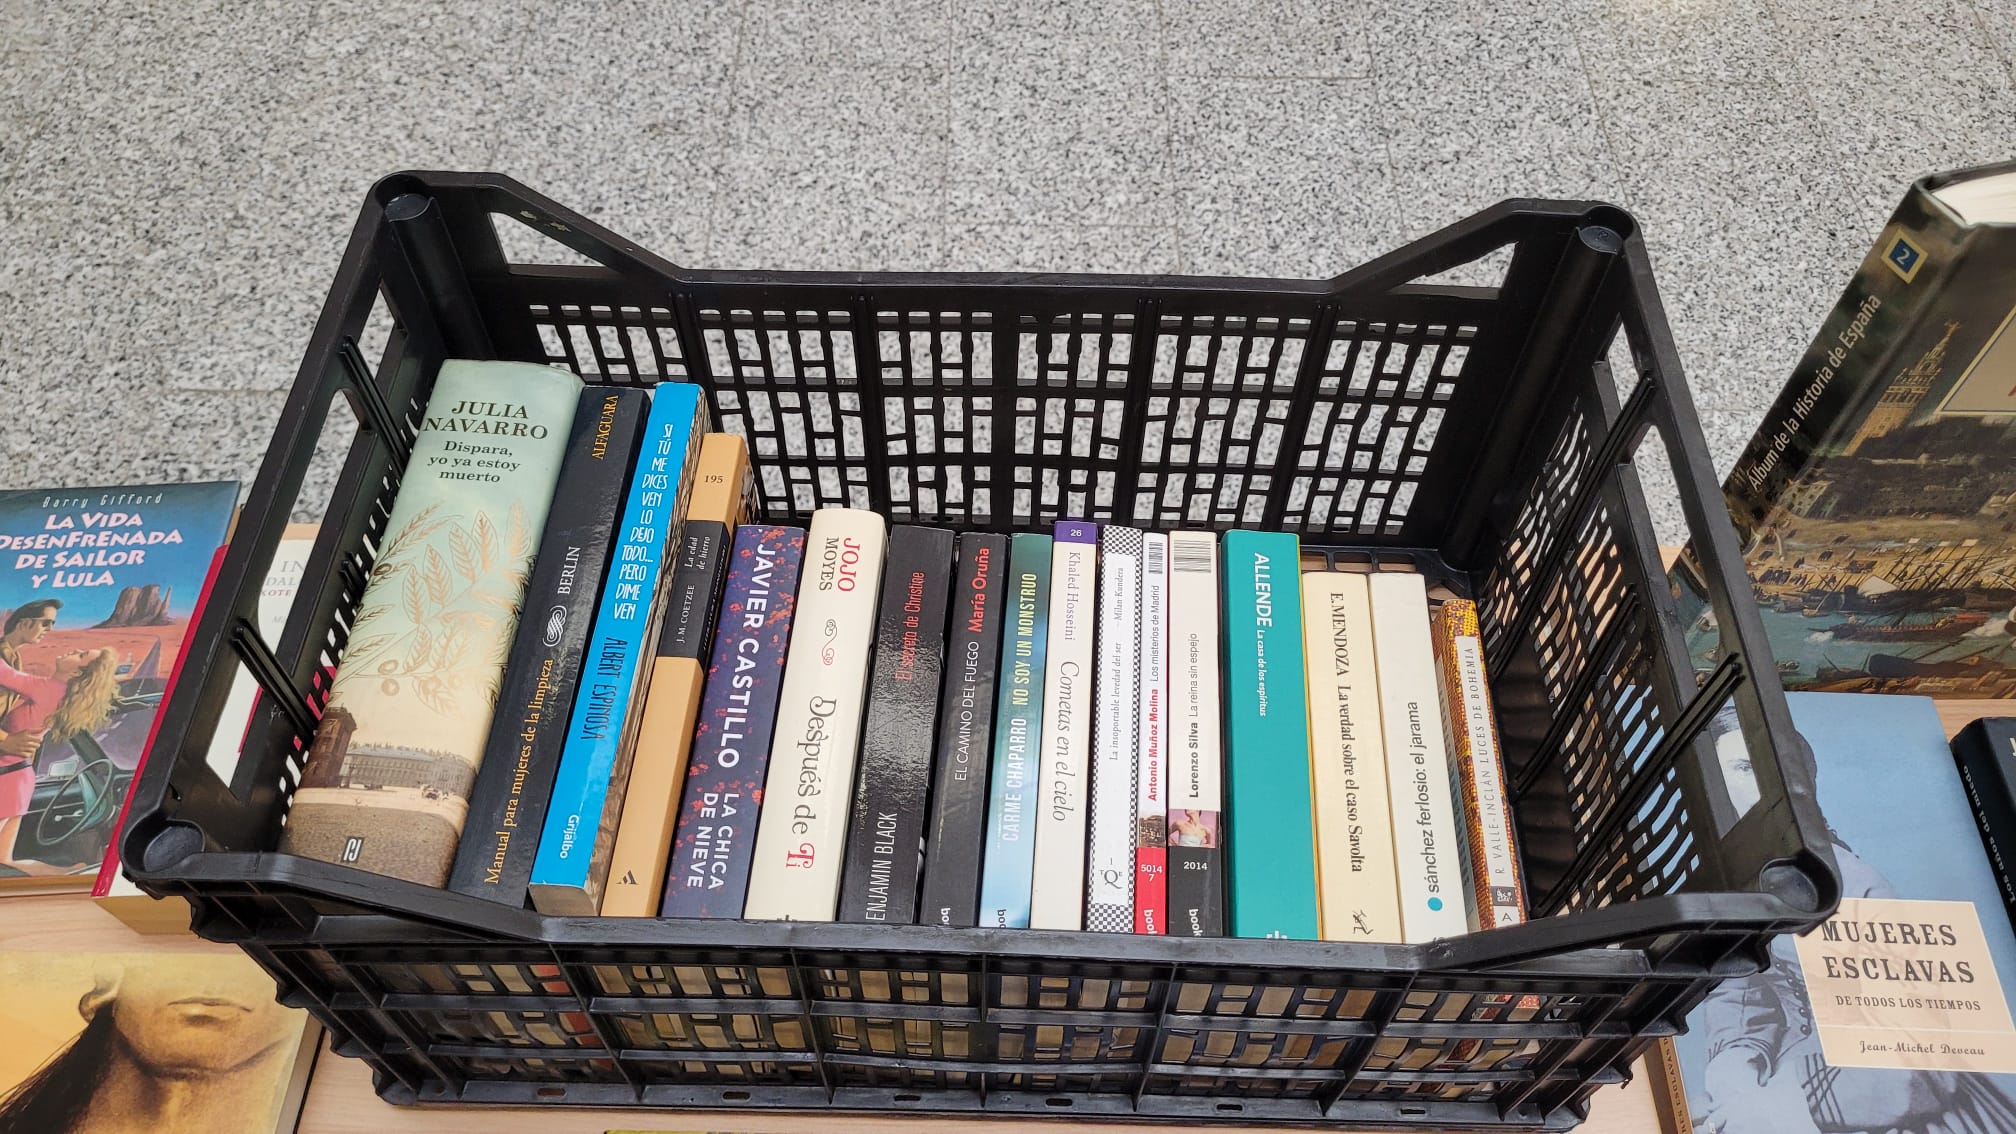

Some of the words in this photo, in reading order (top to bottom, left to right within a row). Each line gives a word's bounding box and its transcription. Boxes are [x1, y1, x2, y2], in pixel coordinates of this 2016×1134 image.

[1896, 247, 1912, 266] 2
[1773, 431, 1790, 452] de
[1782, 417, 1800, 435] la
[1792, 365, 1834, 421] Historia
[1827, 346, 1847, 369] de
[1839, 294, 1882, 349] España
[451, 400, 529, 419] JULIA
[423, 417, 548, 440] NAVARRO
[592, 395, 619, 460] ALFAGUARA
[664, 423, 674, 438] SI
[443, 440, 513, 458] Dispara,
[658, 437, 672, 455] TÚ
[427, 456, 448, 467] yo
[451, 458, 472, 468] ya
[476, 459, 522, 472] estoy
[652, 457, 667, 471] ME
[438, 471, 500, 483] muerto
[641, 474, 668, 489] DICES
[704, 474, 724, 484] 195
[43, 496, 89, 509] Barry
[100, 493, 163, 506] Gifford
[642, 492, 662, 507] VEN
[45, 514, 75, 530] LA
[640, 509, 653, 524] LO
[630, 527, 655, 543] DEJO
[1070, 529, 1082, 537] 26
[688, 536, 699, 556] edad
[698, 536, 711, 559] hierro
[15, 554, 48, 570] DE
[557, 546, 581, 595] BERLIN
[618, 563, 647, 581] PERO
[685, 557, 694, 568] La
[696, 560, 706, 570] de
[818, 537, 840, 592] MOYES
[837, 537, 861, 592] JOJO
[971, 547, 991, 590] Oruña
[1066, 552, 1081, 590] Khaled
[31, 574, 48, 589] Y
[52, 570, 115, 588] LULA
[742, 544, 776, 629] JAVIER
[1114, 567, 1124, 599] Kundera
[1254, 552, 1273, 628] ALLENDE
[615, 584, 641, 600] DIME
[904, 572, 925, 613] Christine
[1150, 585, 1160, 613] Madrid
[613, 603, 636, 620] VEN
[680, 585, 695, 624] COETZEE
[968, 593, 986, 633] María
[1017, 573, 1037, 636] MONSTRUO
[1113, 601, 1123, 621] Milan
[902, 615, 920, 629] de
[1064, 593, 1079, 641] Hosseini
[1150, 615, 1160, 626] de
[1149, 627, 1160, 664] misterios
[1257, 630, 1266, 639] La
[597, 637, 628, 678] ALBERT
[901, 631, 918, 667] secreto
[1016, 640, 1032, 657] UN
[1190, 633, 1201, 663] espejo
[1257, 641, 1265, 657] casa
[964, 641, 980, 682] FUEGO
[1014, 660, 1031, 684] SOY
[1112, 655, 1121, 666] del
[1190, 663, 1198, 678] sin
[1257, 658, 1268, 669] de
[528, 659, 554, 708] limpieza
[895, 670, 913, 682] El
[1111, 668, 1121, 697] levedad
[1150, 664, 1160, 682] Los
[1258, 670, 1268, 681] los
[1464, 648, 1480, 699] BOHEMIA
[717, 638, 760, 768] CASTILLO
[962, 685, 976, 708] DEL
[1012, 689, 1028, 705] NO
[1057, 661, 1080, 731] Cometas
[1189, 680, 1198, 703] reina
[1256, 682, 1268, 717] espíritus
[1337, 685, 1352, 701] La
[580, 684, 617, 741] ESPINOSA
[1149, 689, 1159, 721] Molina
[1189, 705, 1198, 717] La
[1472, 706, 1483, 719] DE
[530, 711, 541, 725] la
[1110, 698, 1121, 750] insoportable
[1339, 704, 1356, 741] verdad
[1408, 702, 1428, 748] jarama
[521, 726, 537, 742] de
[956, 711, 973, 764] CAMINO
[1057, 737, 1070, 755] en
[1148, 724, 1158, 758] Muñoz
[1189, 722, 1198, 748] Silva
[1475, 726, 1489, 763] LUCES
[797, 696, 837, 797] Después
[1006, 719, 1028, 788] CHAPARRO
[1110, 752, 1119, 760] La
[1410, 752, 1425, 765] el
[511, 744, 532, 795] mujeres
[1055, 761, 1076, 777] el
[1342, 744, 1357, 776] sobre
[954, 767, 968, 781] EL
[1148, 759, 1158, 801] Antonio
[1189, 752, 1199, 798] Lorenzo
[1345, 779, 1360, 790] el
[700, 792, 719, 819] DE
[721, 793, 740, 818] LA
[1053, 781, 1074, 821] cielo
[1346, 792, 1359, 822] caso
[1413, 768, 1432, 826] ferlosio:
[503, 799, 519, 828] para
[792, 804, 816, 835] de
[1002, 793, 1022, 841] CARME
[559, 814, 580, 859] Grijalbo
[873, 812, 898, 854] BLACK
[484, 831, 511, 884] Manual
[687, 826, 713, 888] NIEVE
[707, 825, 734, 889] CHICA
[1348, 825, 1366, 873] Savolta
[1419, 829, 1440, 893] sánchez
[1141, 865, 1162, 873] 5014
[1149, 874, 1155, 882] 7
[1184, 862, 1208, 870] 2014
[941, 907, 951, 926] bo
[1822, 920, 1957, 946] MUJERES
[1822, 956, 1974, 983] ESCLAVAS
[1836, 995, 1851, 1006] DE
[1855, 996, 1896, 1007] TODOS
[1899, 998, 1923, 1008] LOS
[1926, 999, 1981, 1011] TIEMPOS
[1860, 1041, 1935, 1054] Jean-Michel
